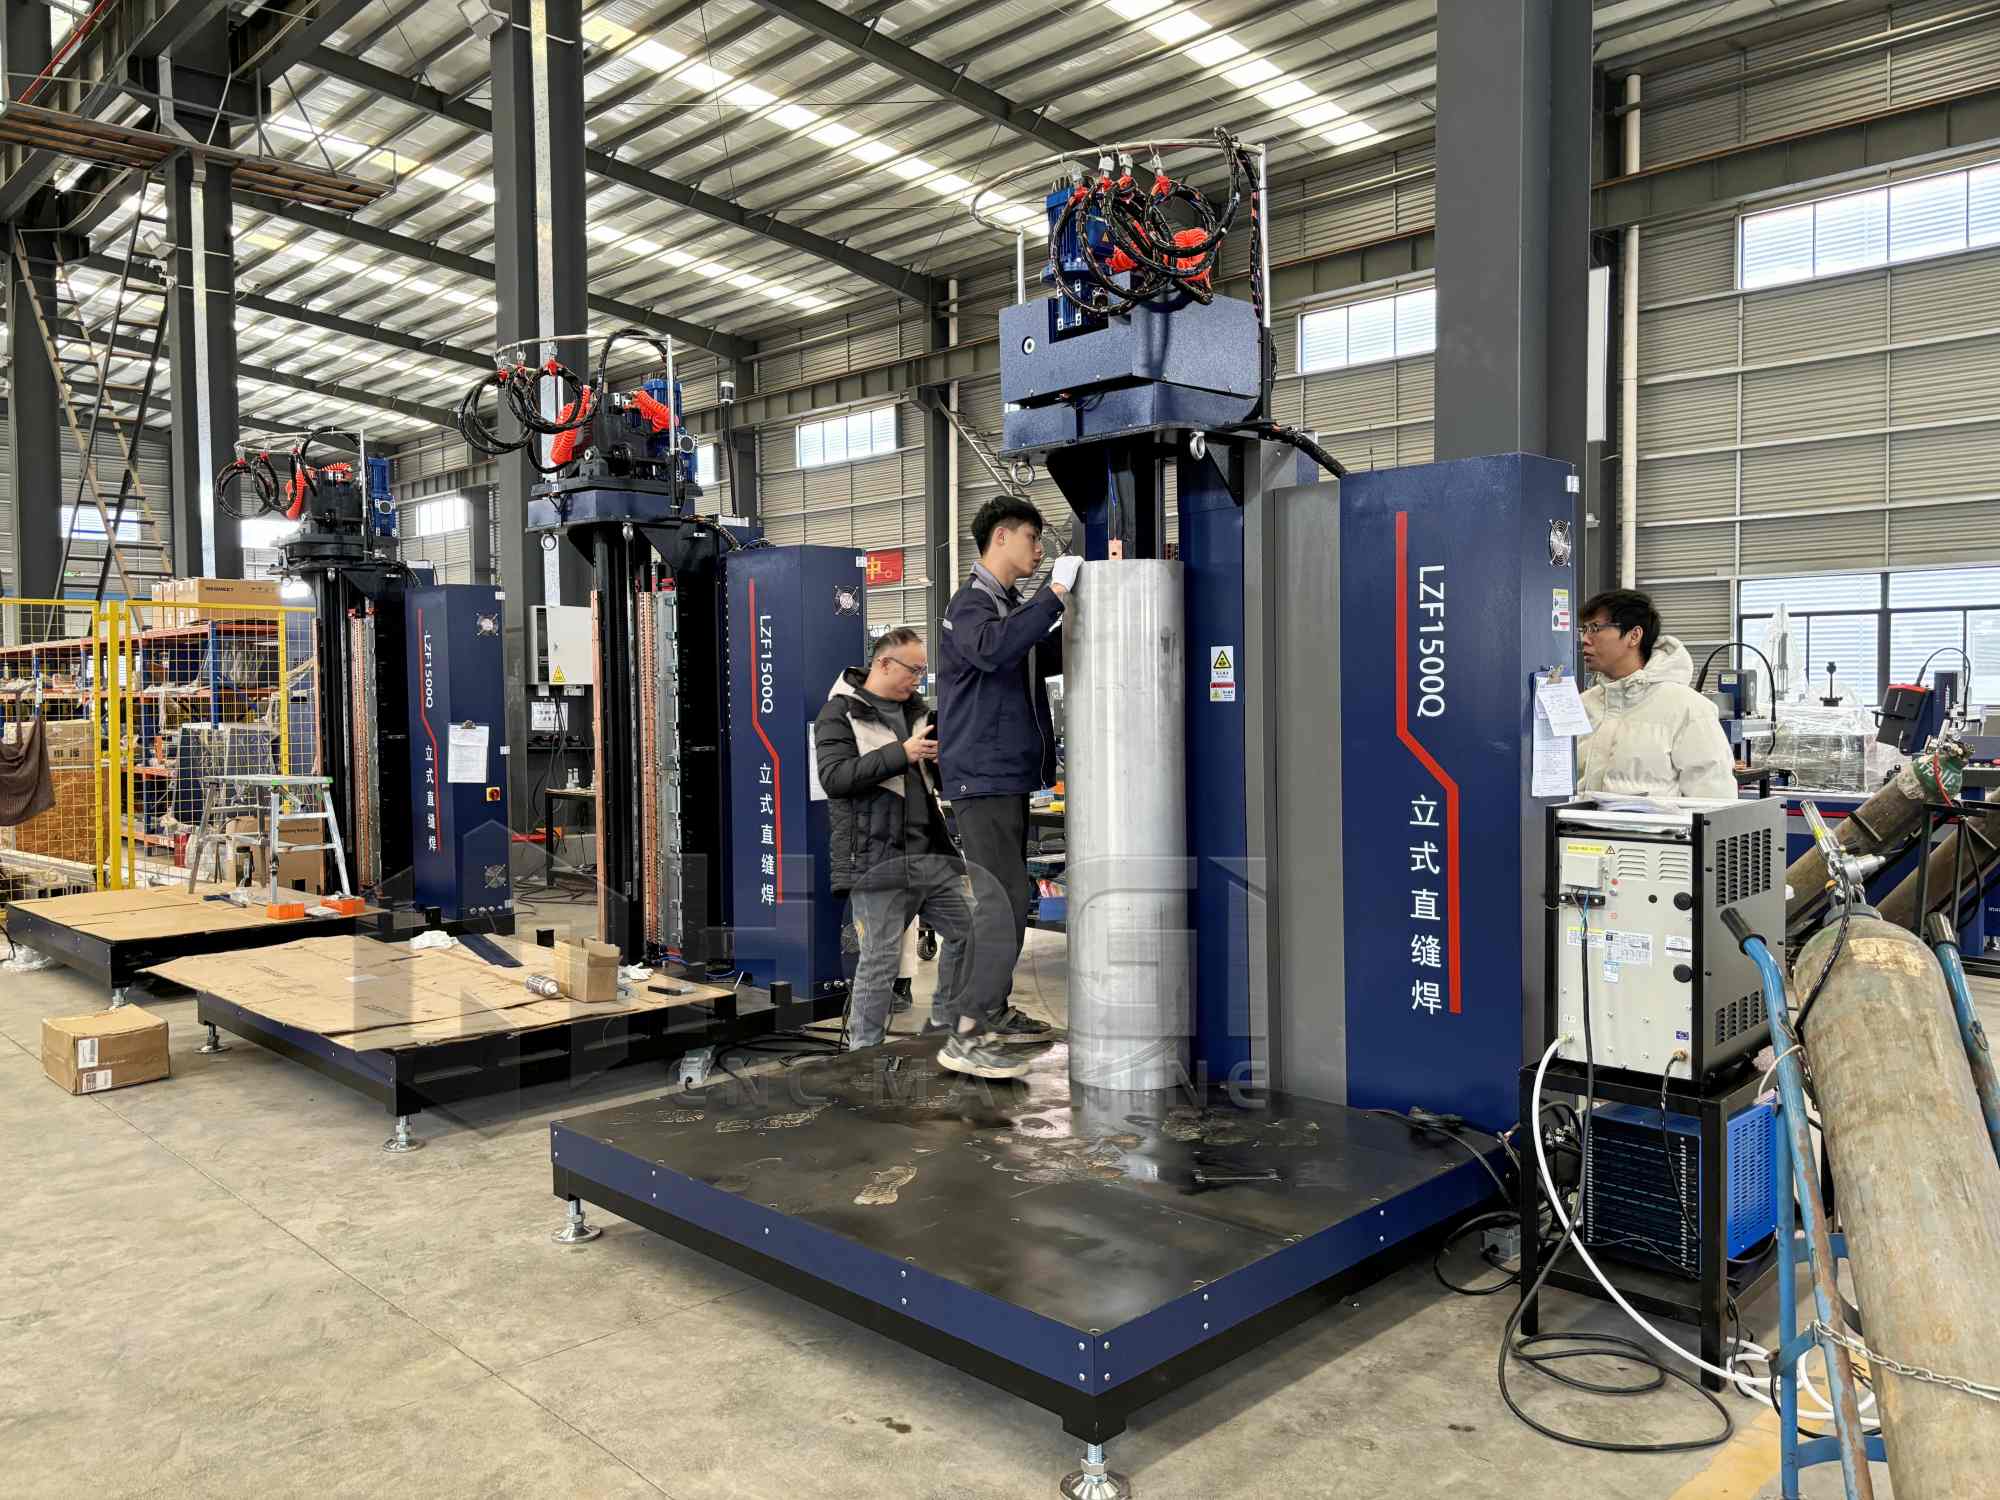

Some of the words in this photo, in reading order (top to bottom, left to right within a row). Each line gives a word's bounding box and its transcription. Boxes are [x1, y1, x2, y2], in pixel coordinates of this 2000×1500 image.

[759, 615, 774, 714] LZF1500Q
[1416, 564, 1446, 718] LZF1500Q
[759, 761, 776, 906] 立式直缝焊
[1409, 794, 1443, 1016] 立式直缝焊
